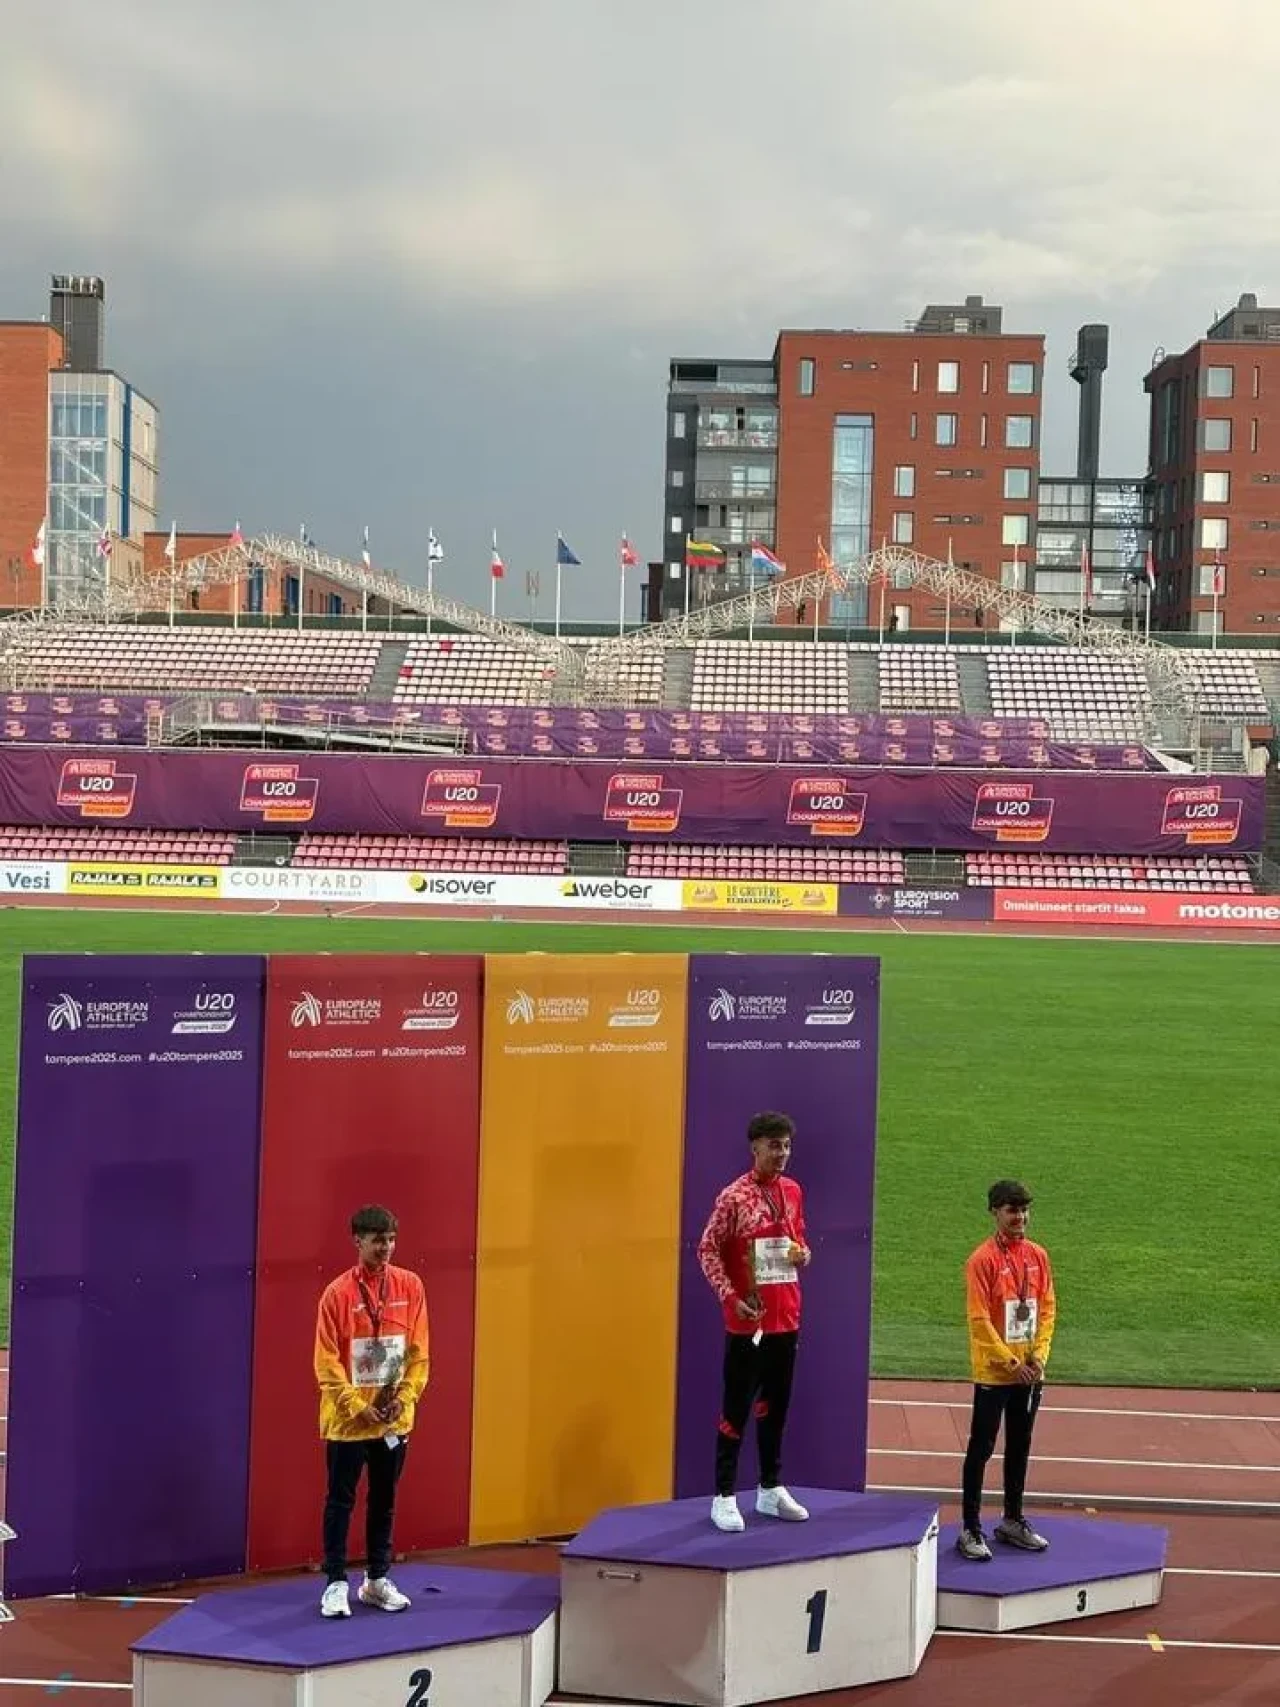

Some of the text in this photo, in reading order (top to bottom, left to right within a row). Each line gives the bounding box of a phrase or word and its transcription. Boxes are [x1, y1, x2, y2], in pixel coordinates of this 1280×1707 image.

[80, 777, 114, 792] U20
[262, 781, 296, 796] U20
[63, 793, 129, 803] CHAMPIONSHIPS
[445, 786, 478, 801] U20
[627, 792, 661, 807] U20
[244, 798, 312, 807] CHAMPIONSHIPS
[426, 803, 492, 813] CHAMPIONSHIPS
[810, 796, 844, 810] U20
[995, 801, 1030, 816] U20
[609, 808, 675, 818] CHAMPIONSHIPS
[792, 811, 858, 822] CHAMPIONSHIPS
[1185, 803, 1219, 818] U20
[977, 817, 1045, 828] CHAMPIONSHIPS
[1166, 820, 1234, 830] CHAMPIONSHIPS
[5, 871, 50, 890] Vesi
[72, 872, 124, 885] RAJALA
[150, 874, 199, 887] RAJALA
[230, 871, 362, 889] COURTYARD
[579, 879, 652, 899] weber
[893, 899, 929, 909] SPORT
[1003, 899, 1146, 915] Onnistuneet startit takaa
[195, 993, 235, 1011] U20
[422, 991, 458, 1007] U20
[538, 997, 589, 1007] EUROPEAN
[626, 989, 660, 1006] U20
[738, 996, 786, 1005] EUROPEAN
[822, 989, 854, 1004] U20
[86, 1002, 148, 1011] EUROPEAN
[326, 1000, 381, 1009] EUROPEAN
[738, 1005, 787, 1015] ATHLETICS
[86, 1012, 148, 1022] ATHLETICS
[173, 1011, 232, 1019] CHAMPIONSHIPS
[325, 1009, 380, 1019] ATHLETICS
[538, 1007, 588, 1017] ATHLETICS
[707, 1040, 783, 1051] tampere2025.com
[45, 1050, 243, 1065] tampere2025.com #u20tampere2025
[288, 1045, 467, 1060] tampere2025.com #u20tampere2025
[1077, 1590, 1087, 1612] 3
[806, 1590, 827, 1654] 1
[407, 1668, 432, 1707] 2
